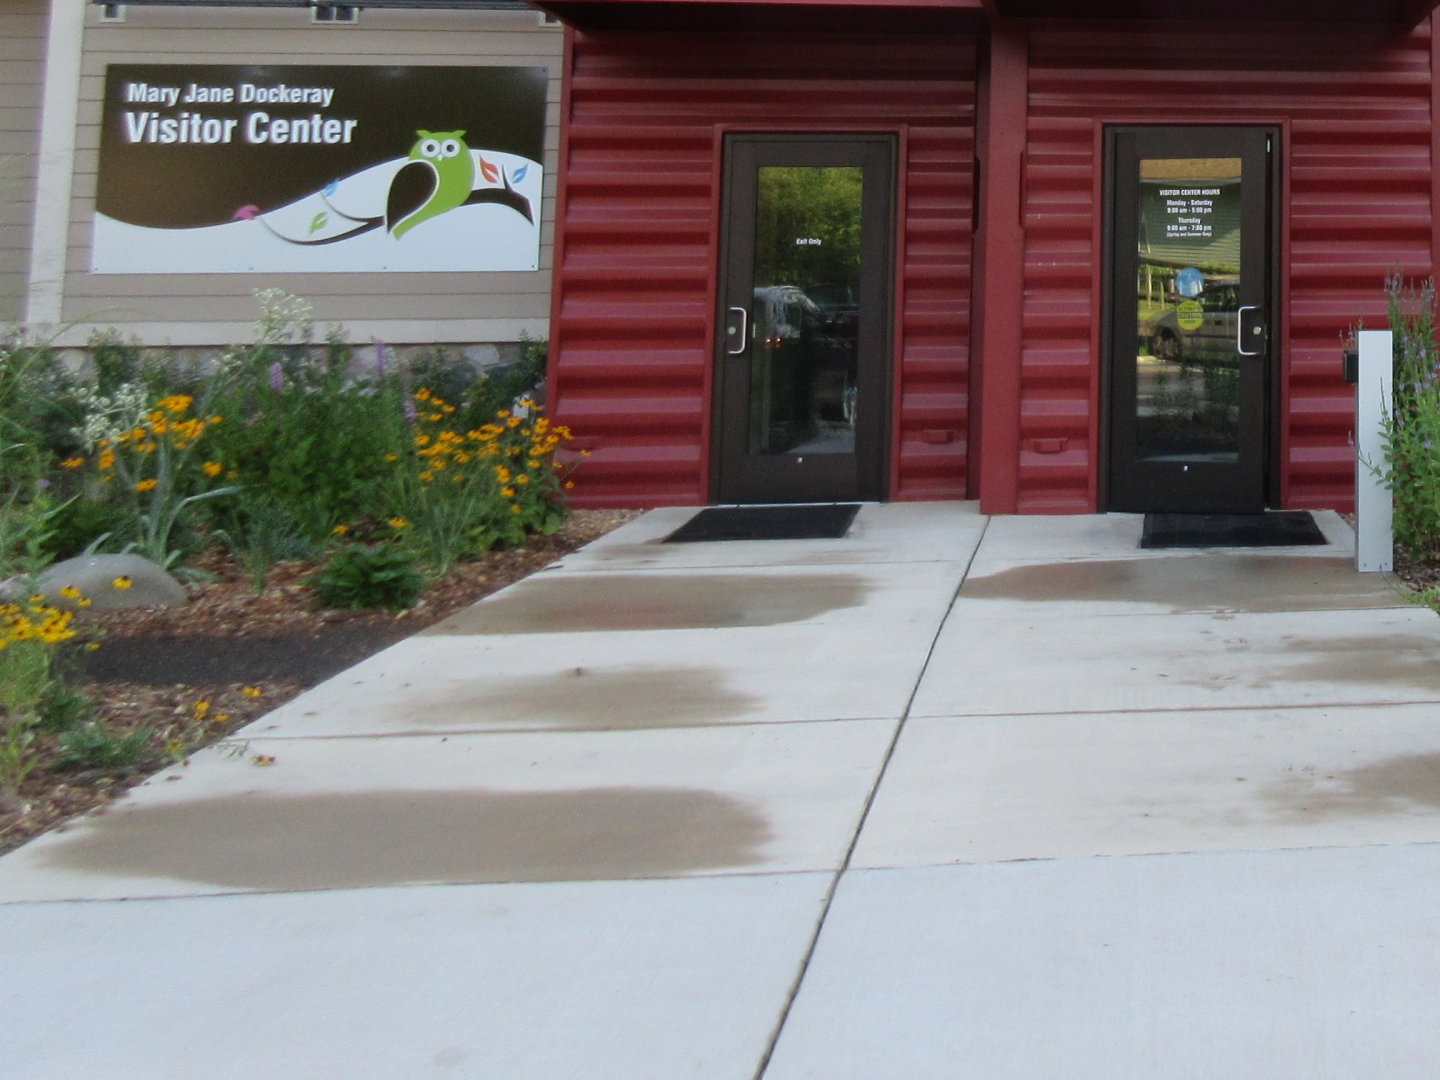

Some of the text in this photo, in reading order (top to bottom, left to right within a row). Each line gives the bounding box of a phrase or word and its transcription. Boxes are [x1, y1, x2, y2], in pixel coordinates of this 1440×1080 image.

[127, 83, 335, 108] Mary Jane Dockeray
[126, 111, 358, 144] Visitor Center
[808, 237, 821, 246] Only
